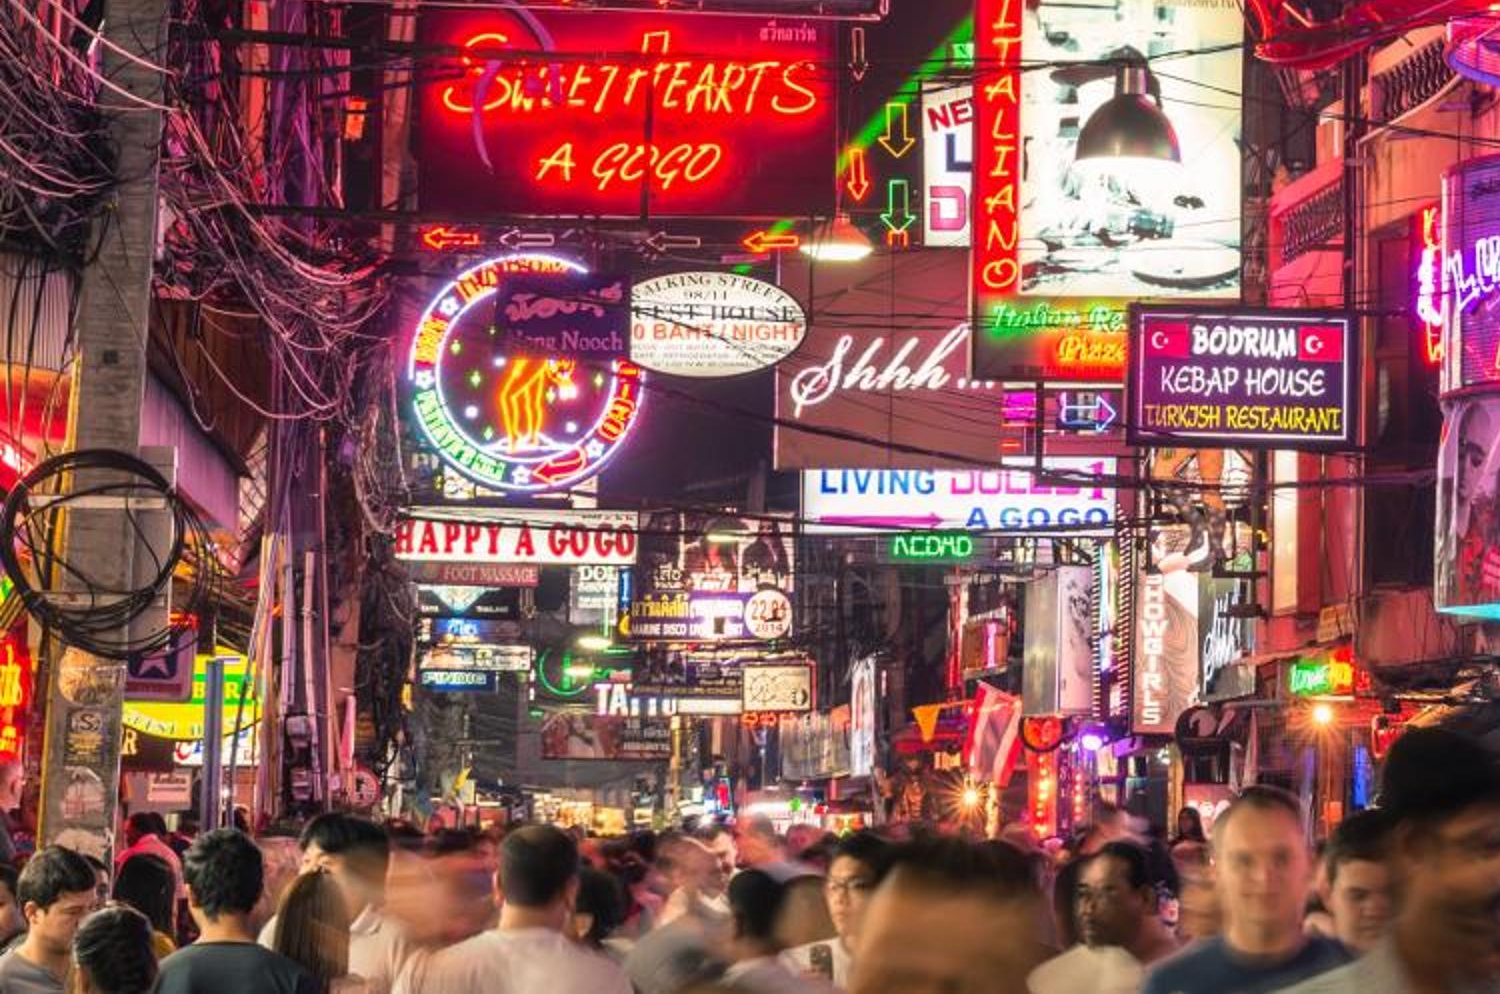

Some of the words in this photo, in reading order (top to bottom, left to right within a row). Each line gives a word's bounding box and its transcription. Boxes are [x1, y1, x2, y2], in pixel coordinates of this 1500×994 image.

[928, 98, 973, 133] NE
[536, 142, 576, 180] A
[1192, 325, 1297, 360] BODRUM
[1161, 365, 1239, 397] KEBAP
[1245, 368, 1326, 397] HOUSE
[1145, 404, 1221, 428] TURKISH
[1226, 407, 1343, 433] RESTAURANT
[820, 468, 936, 495] LIVING
[966, 507, 989, 529] A
[395, 519, 501, 555] HAPPY
[515, 522, 535, 556] A
[548, 523, 636, 557] GOGO
